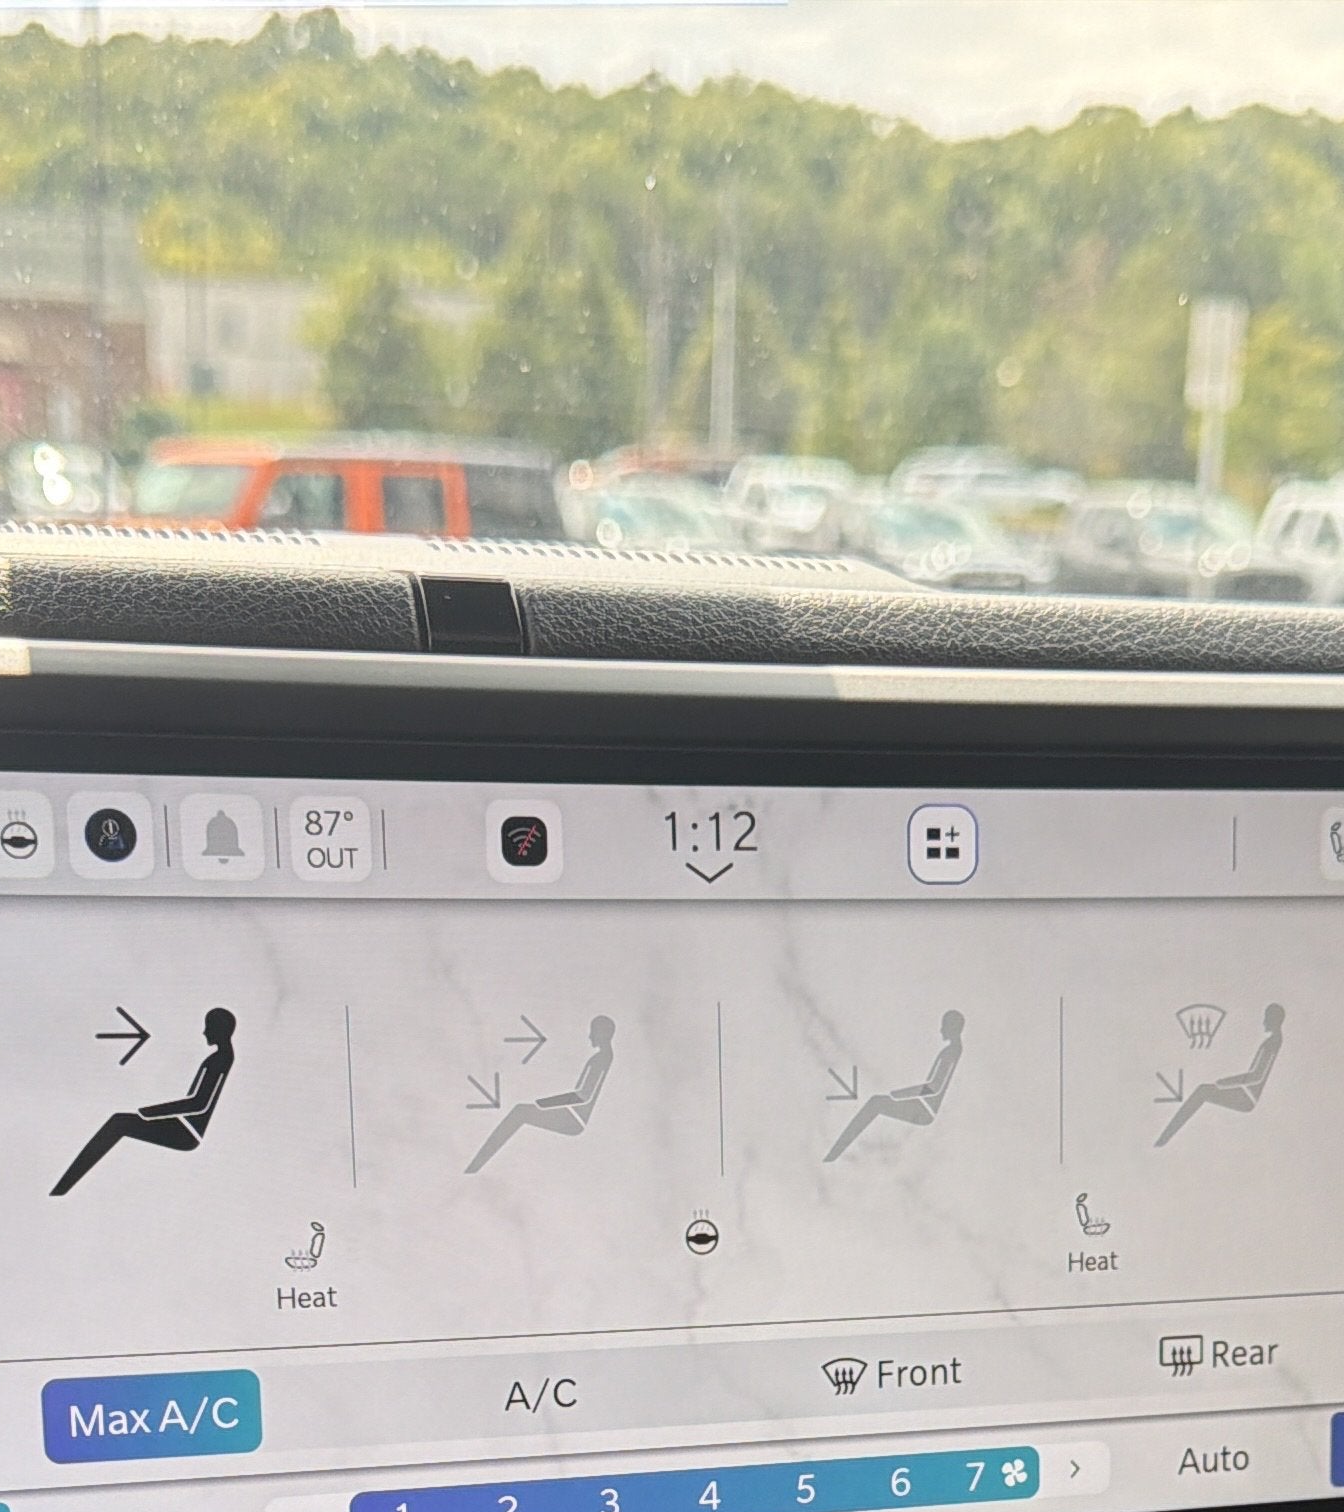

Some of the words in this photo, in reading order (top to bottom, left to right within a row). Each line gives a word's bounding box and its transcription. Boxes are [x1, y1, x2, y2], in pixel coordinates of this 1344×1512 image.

[304, 809, 355, 837] 87°
[662, 810, 759, 853] 1:12
[306, 847, 359, 871] OUT
[1067, 1251, 1119, 1274] Heat
[275, 1285, 338, 1311] Heat
[1211, 1337, 1279, 1369] Rear
[876, 1355, 963, 1390] Front
[504, 1378, 579, 1414] A/C
[68, 1404, 151, 1439] Max
[158, 1396, 241, 1435] A/C
[1177, 1444, 1250, 1476] Auto
[698, 1481, 723, 1512] 4
[795, 1474, 816, 1505] 5
[890, 1466, 912, 1498] 6
[965, 1462, 986, 1493] 7
